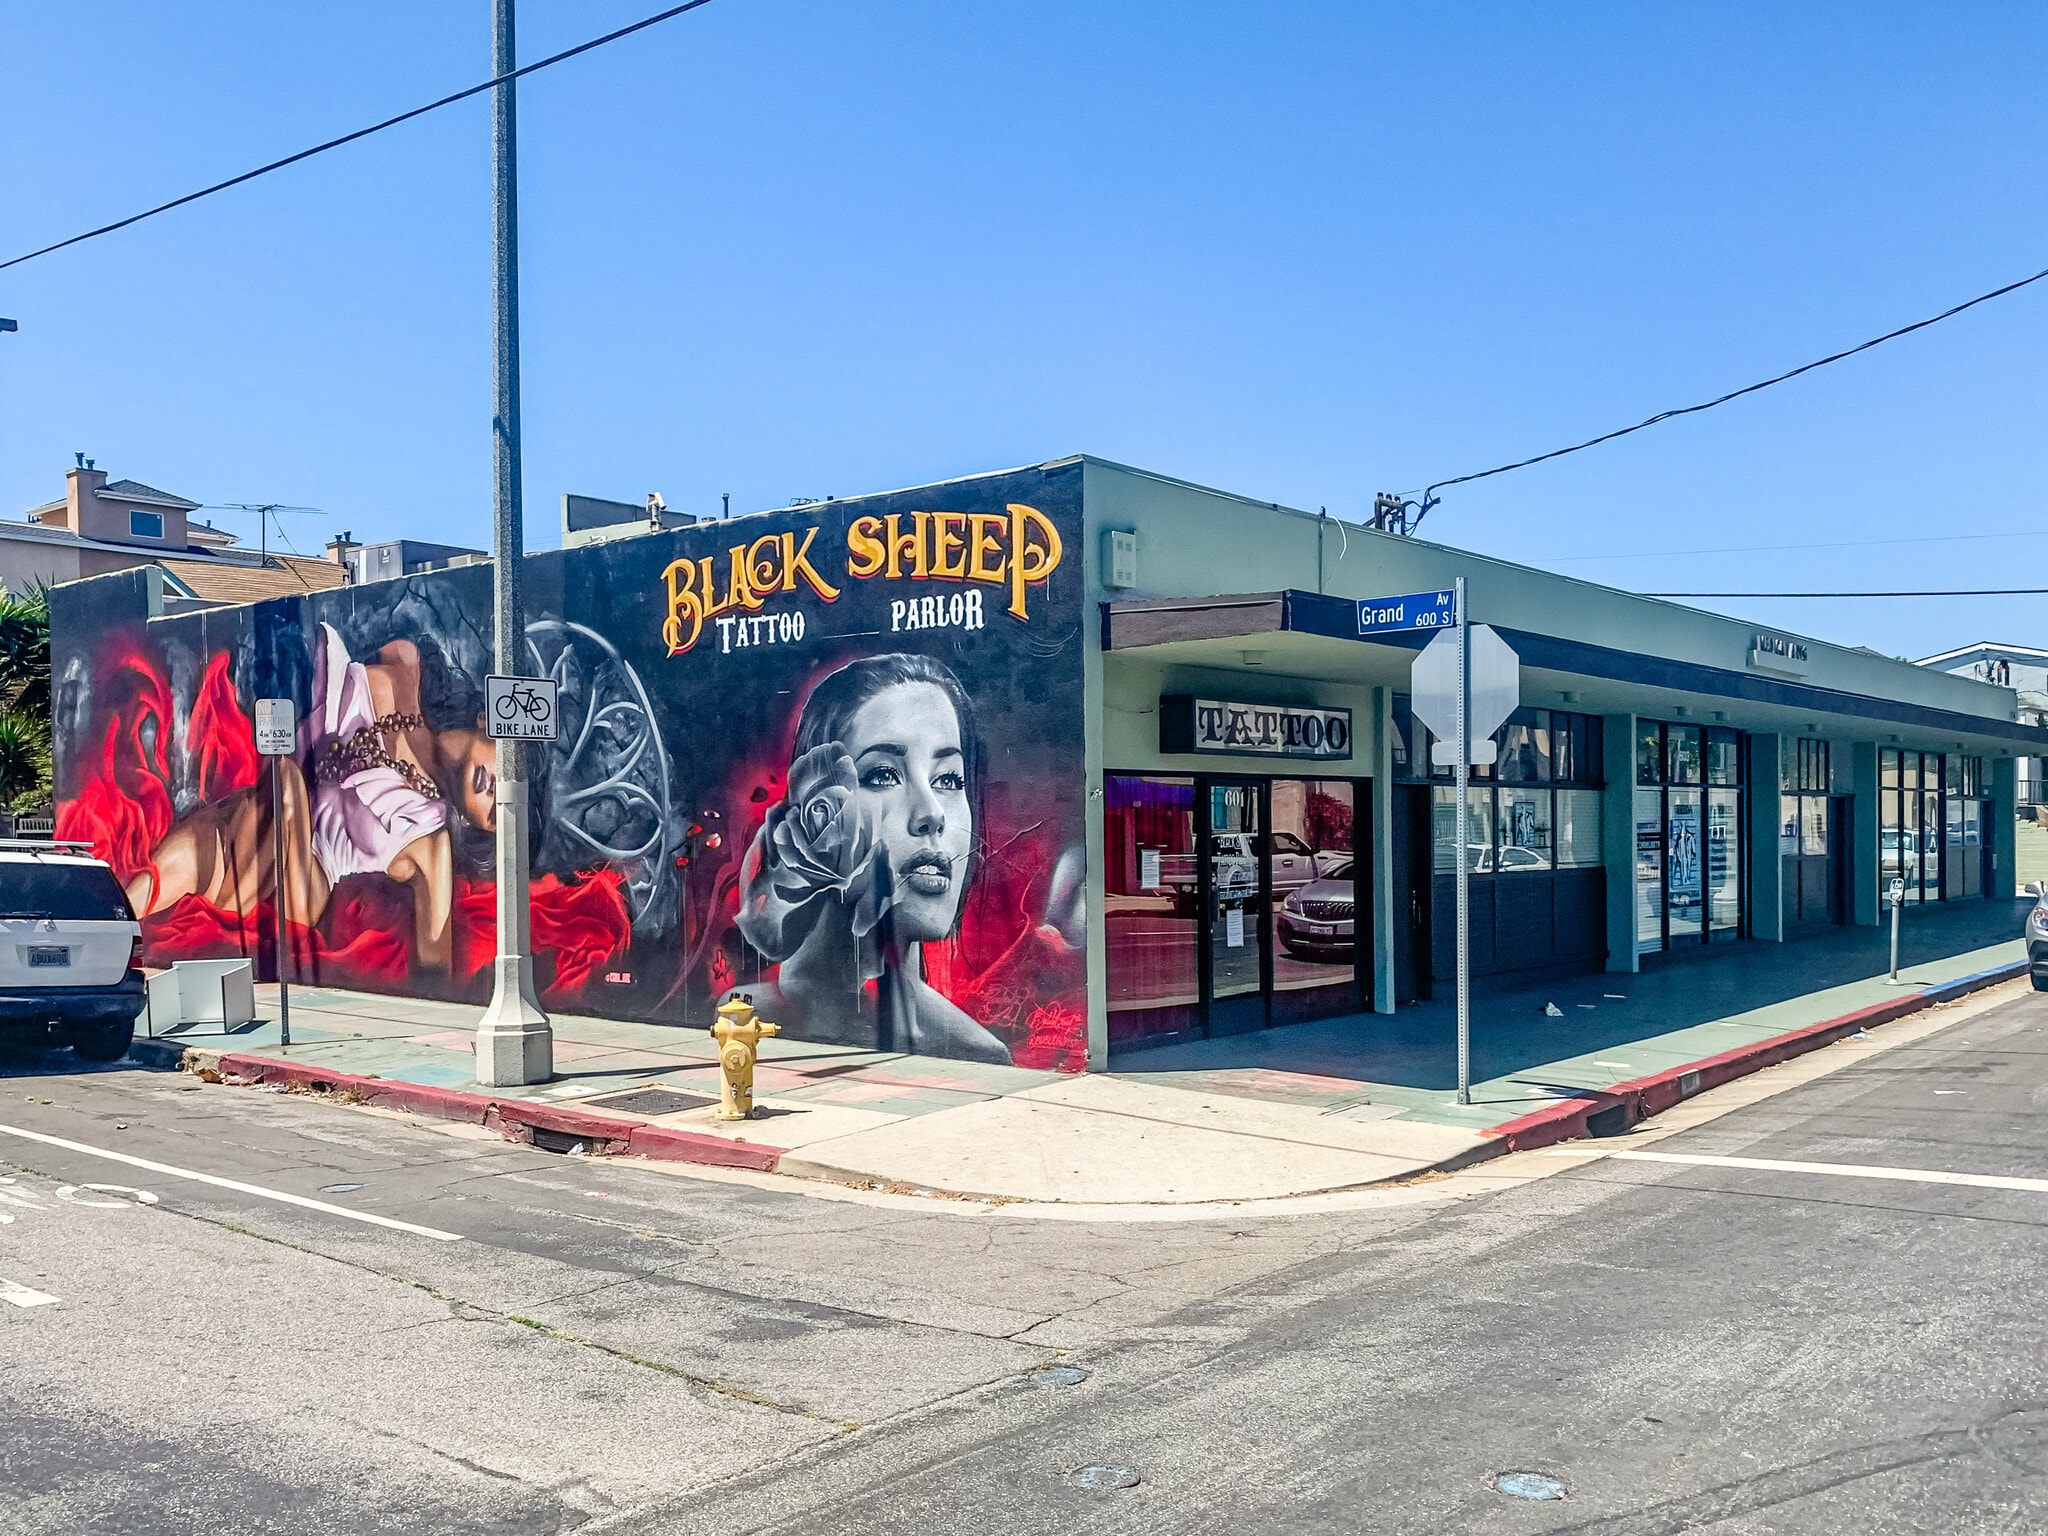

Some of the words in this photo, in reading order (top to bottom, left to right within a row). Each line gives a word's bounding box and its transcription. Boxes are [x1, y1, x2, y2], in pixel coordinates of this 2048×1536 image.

[660, 526, 841, 659] BLACK
[846, 503, 1063, 620] SHEEP
[715, 611, 805, 654] TATTOO
[890, 588, 985, 632] PARLOR
[1361, 602, 1404, 625] Grand
[1436, 592, 1449, 606] Av
[1415, 612, 1437, 627] 600
[1442, 611, 1449, 624] S
[496, 722, 520, 735] BIKE
[522, 724, 550, 736] LANE
[1198, 706, 1348, 750] TATTOO
[1224, 790, 1245, 807] 601
